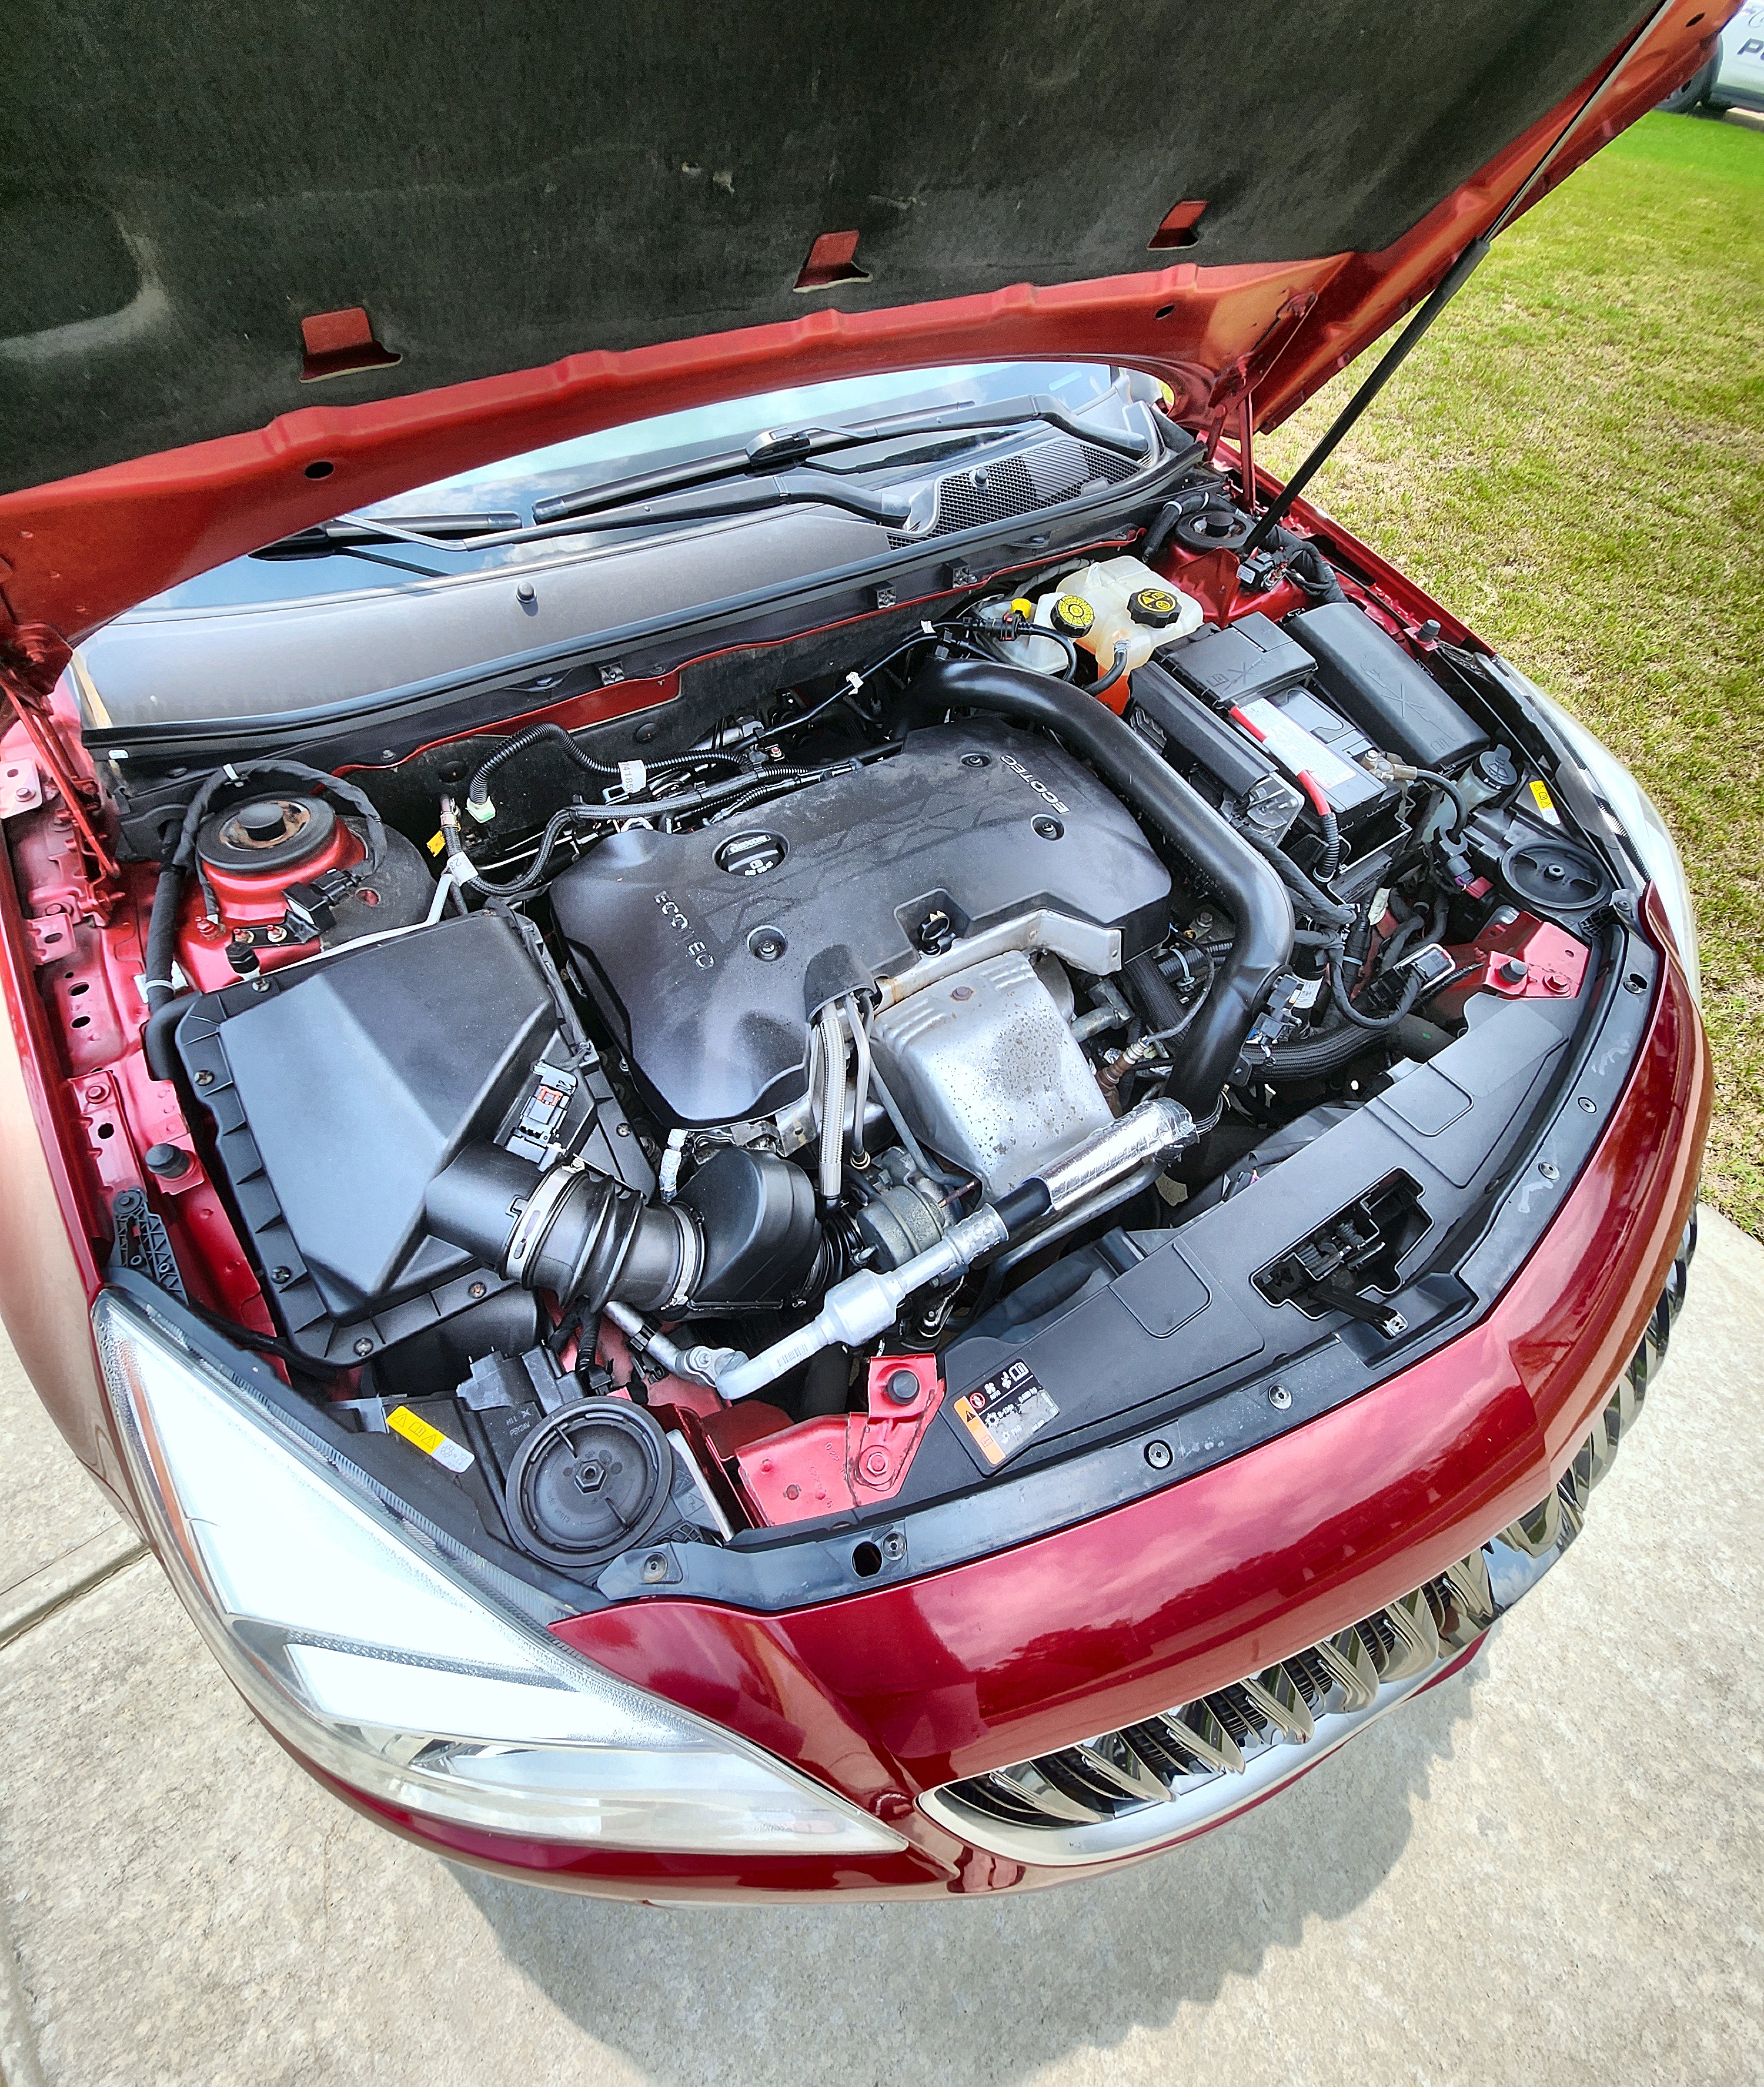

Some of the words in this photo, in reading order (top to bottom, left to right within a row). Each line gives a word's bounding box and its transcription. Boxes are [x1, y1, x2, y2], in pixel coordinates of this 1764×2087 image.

[1737, 38, 1764, 61] P
[1000, 755, 1070, 814] ECOTEC
[730, 835, 768, 853] dexos
